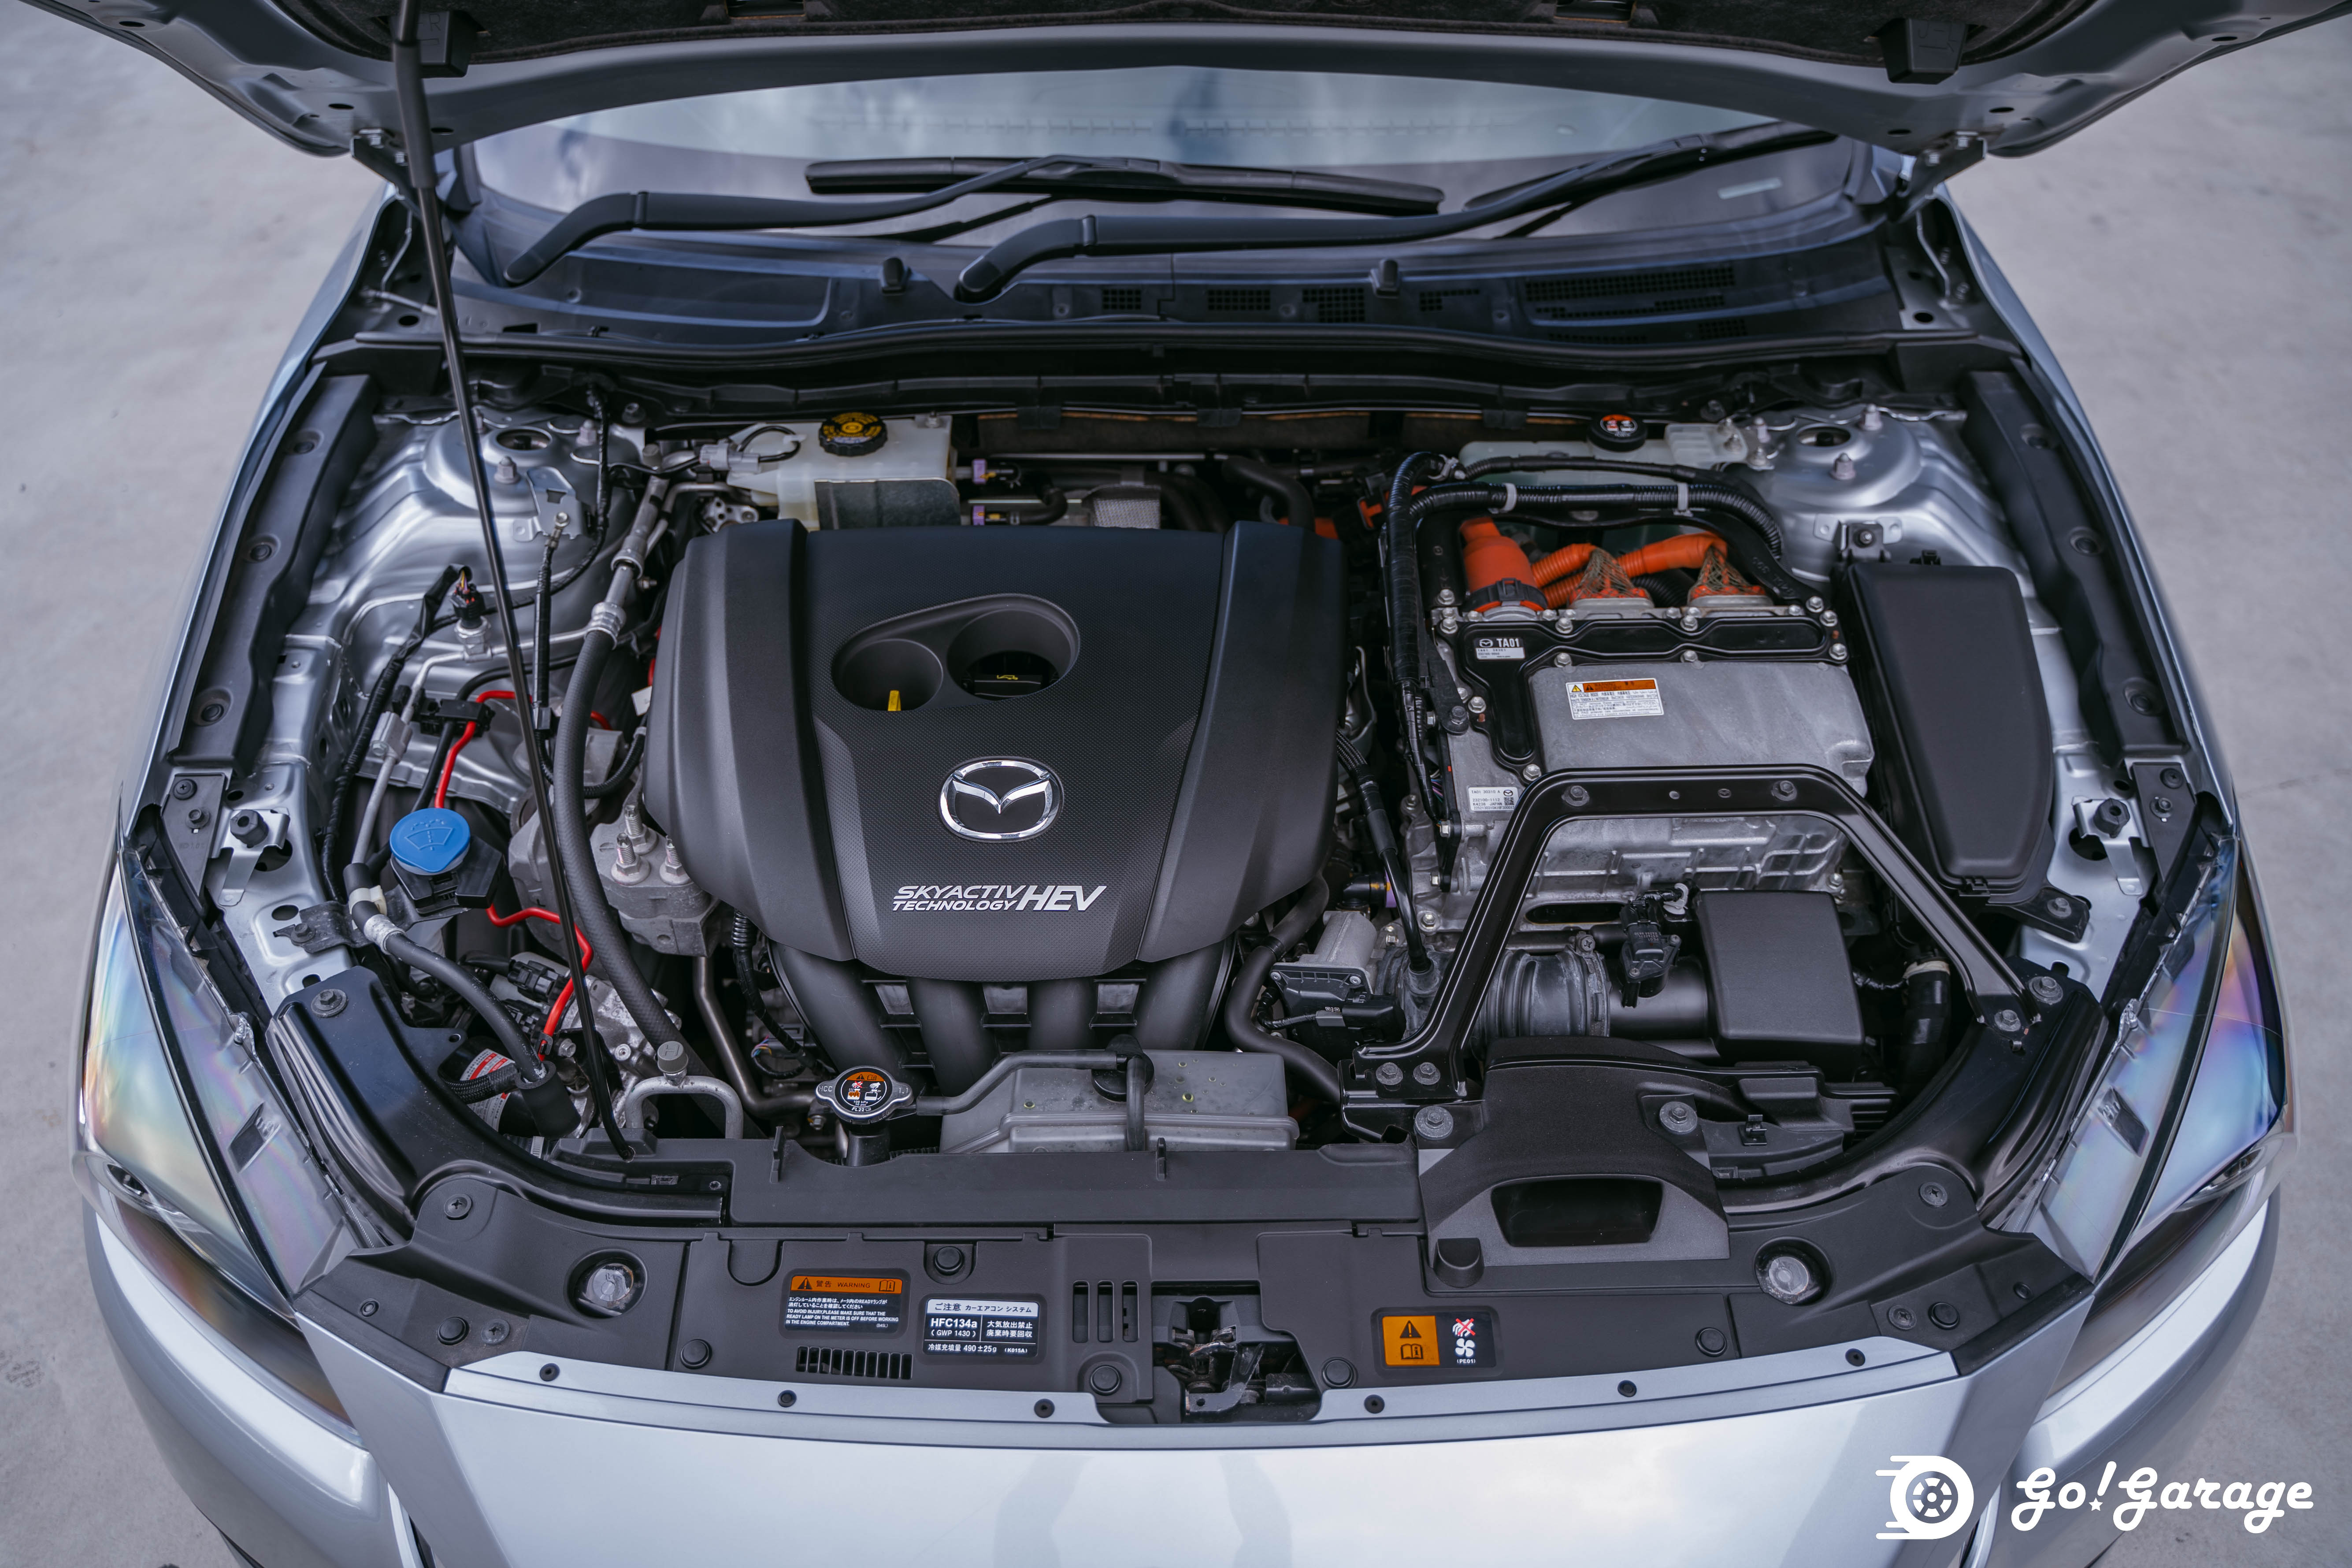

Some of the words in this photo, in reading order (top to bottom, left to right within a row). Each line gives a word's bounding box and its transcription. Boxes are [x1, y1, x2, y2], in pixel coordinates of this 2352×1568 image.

[1496, 638, 1520, 647] TA01
[893, 885, 1026, 899] SKYACTIV
[1015, 885, 1107, 911] HEV
[892, 900, 1018, 911] TECHNOLOGY
[935, 1302, 961, 1311] ご注意
[931, 1318, 977, 1328] HFC134a
[987, 1320, 1033, 1329] 大気放出禁止
[986, 1329, 1032, 1338] 廃棄時要回収
[927, 1343, 961, 1352] 冷媒充填量
